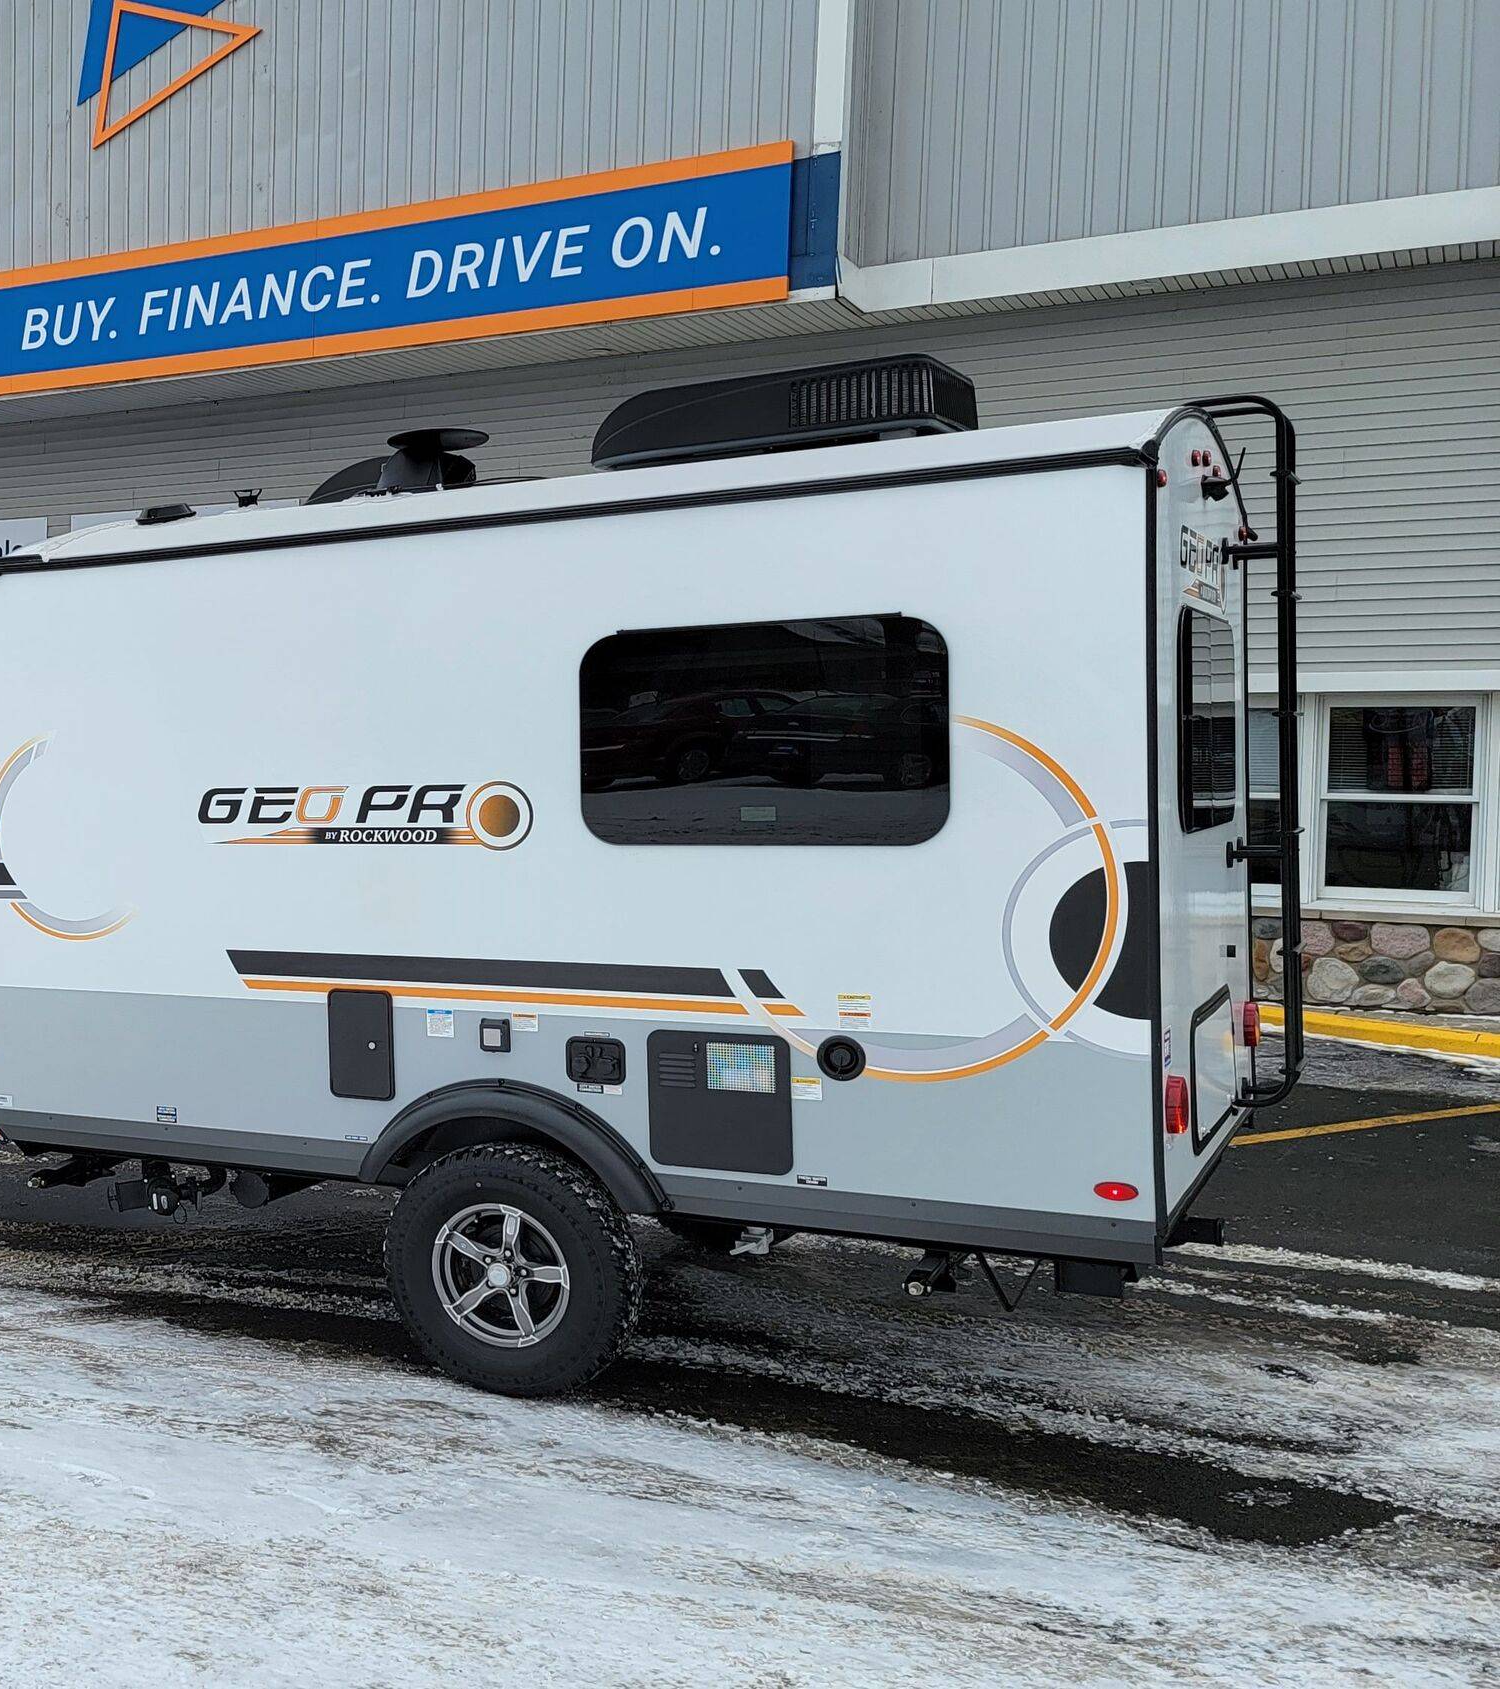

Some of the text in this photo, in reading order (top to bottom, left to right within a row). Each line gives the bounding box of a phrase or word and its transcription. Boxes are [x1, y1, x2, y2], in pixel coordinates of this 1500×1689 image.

[21, 206, 721, 351] BUY. FINANCE. DRIVE ON.
[198, 786, 349, 824] GEO
[325, 829, 438, 844] BY ROCKWOOD
